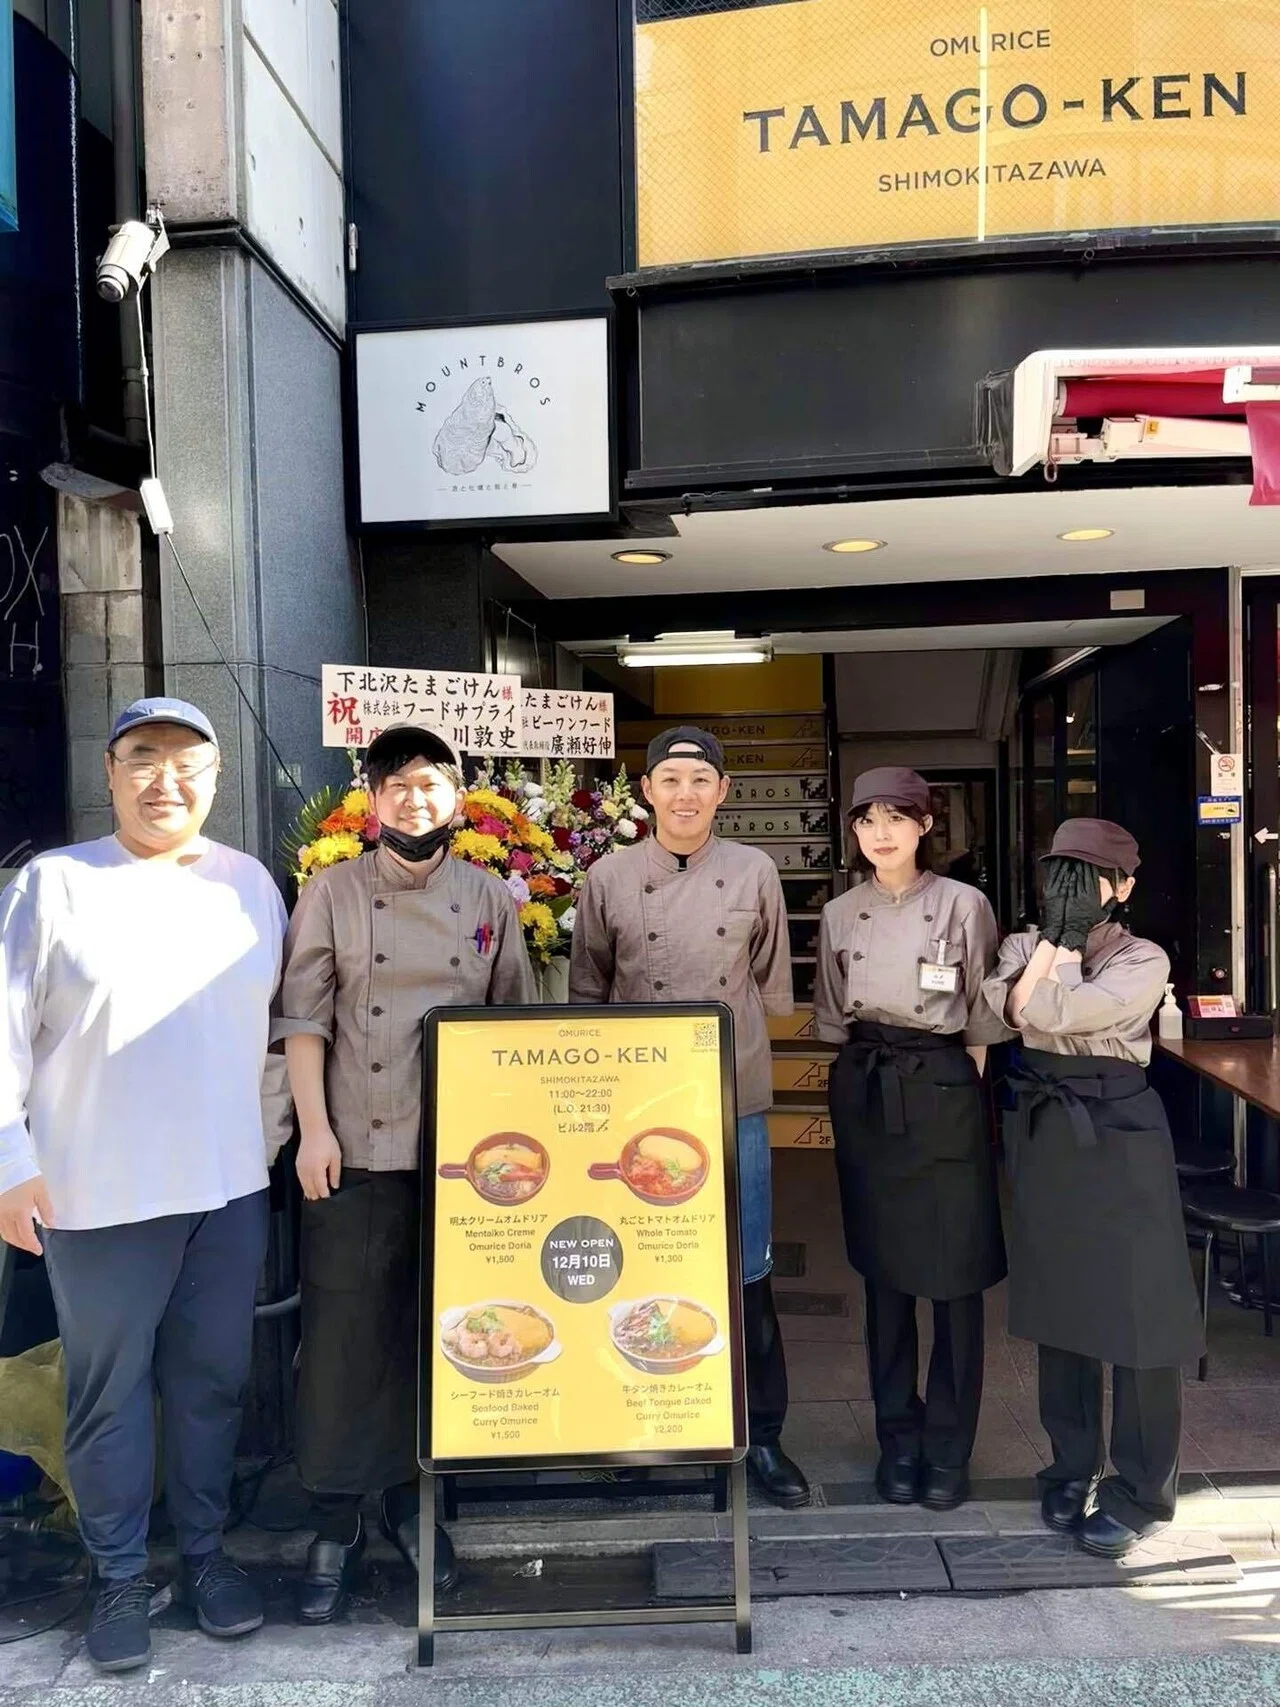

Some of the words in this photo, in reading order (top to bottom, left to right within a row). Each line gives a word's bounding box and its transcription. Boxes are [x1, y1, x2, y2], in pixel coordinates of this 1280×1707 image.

[930, 29, 1051, 57] OMURICE
[742, 71, 1248, 153] TAMAGO-KEN
[878, 158, 1106, 193] SHIMOKITAZAWA
[520, 692, 608, 712] たまごけん様
[327, 692, 361, 725] 祝
[438, 724, 518, 749] 川敦史
[736, 788, 790, 799] BROS
[718, 821, 789, 832] TBROS
[559, 1029, 601, 1038] OMURICE
[492, 1046, 668, 1067] TAMAGO-KEN
[540, 1075, 620, 1085] SHIMOKITAZAWA
[580, 1103, 611, 1115] 21:30)
[558, 1122, 594, 1133] ビル2階
[450, 1214, 548, 1226] 明太クリームオムドリア
[619, 1214, 715, 1225] 丸ごとトマトオムドリア
[465, 1229, 505, 1238] Mentaiko
[636, 1229, 663, 1237] Whole
[665, 1228, 697, 1237] Tomato
[469, 1242, 506, 1251] Omurice
[508, 1241, 532, 1250] Doria
[549, 1239, 577, 1250] NEW
[581, 1238, 614, 1248] OPEN
[638, 1242, 674, 1251] Omurice
[676, 1241, 699, 1250] Doria
[486, 1255, 515, 1264] ¥1,500
[552, 1254, 611, 1269] 12月10日
[655, 1254, 683, 1263] ¥1,300
[567, 1274, 595, 1286] WED
[622, 1382, 712, 1394] 牛タン焼きカレーオム
[451, 1388, 560, 1400] シーフード焼きカレーオム
[472, 1404, 508, 1413] Seafood
[511, 1403, 539, 1412] Baked
[626, 1398, 646, 1407] Beef
[649, 1398, 681, 1408] Tongue
[684, 1397, 712, 1406] Baked
[635, 1412, 661, 1421] Curry
[662, 1411, 700, 1420] Omurice
[473, 1418, 498, 1427] Curry
[500, 1417, 538, 1426] Omurice
